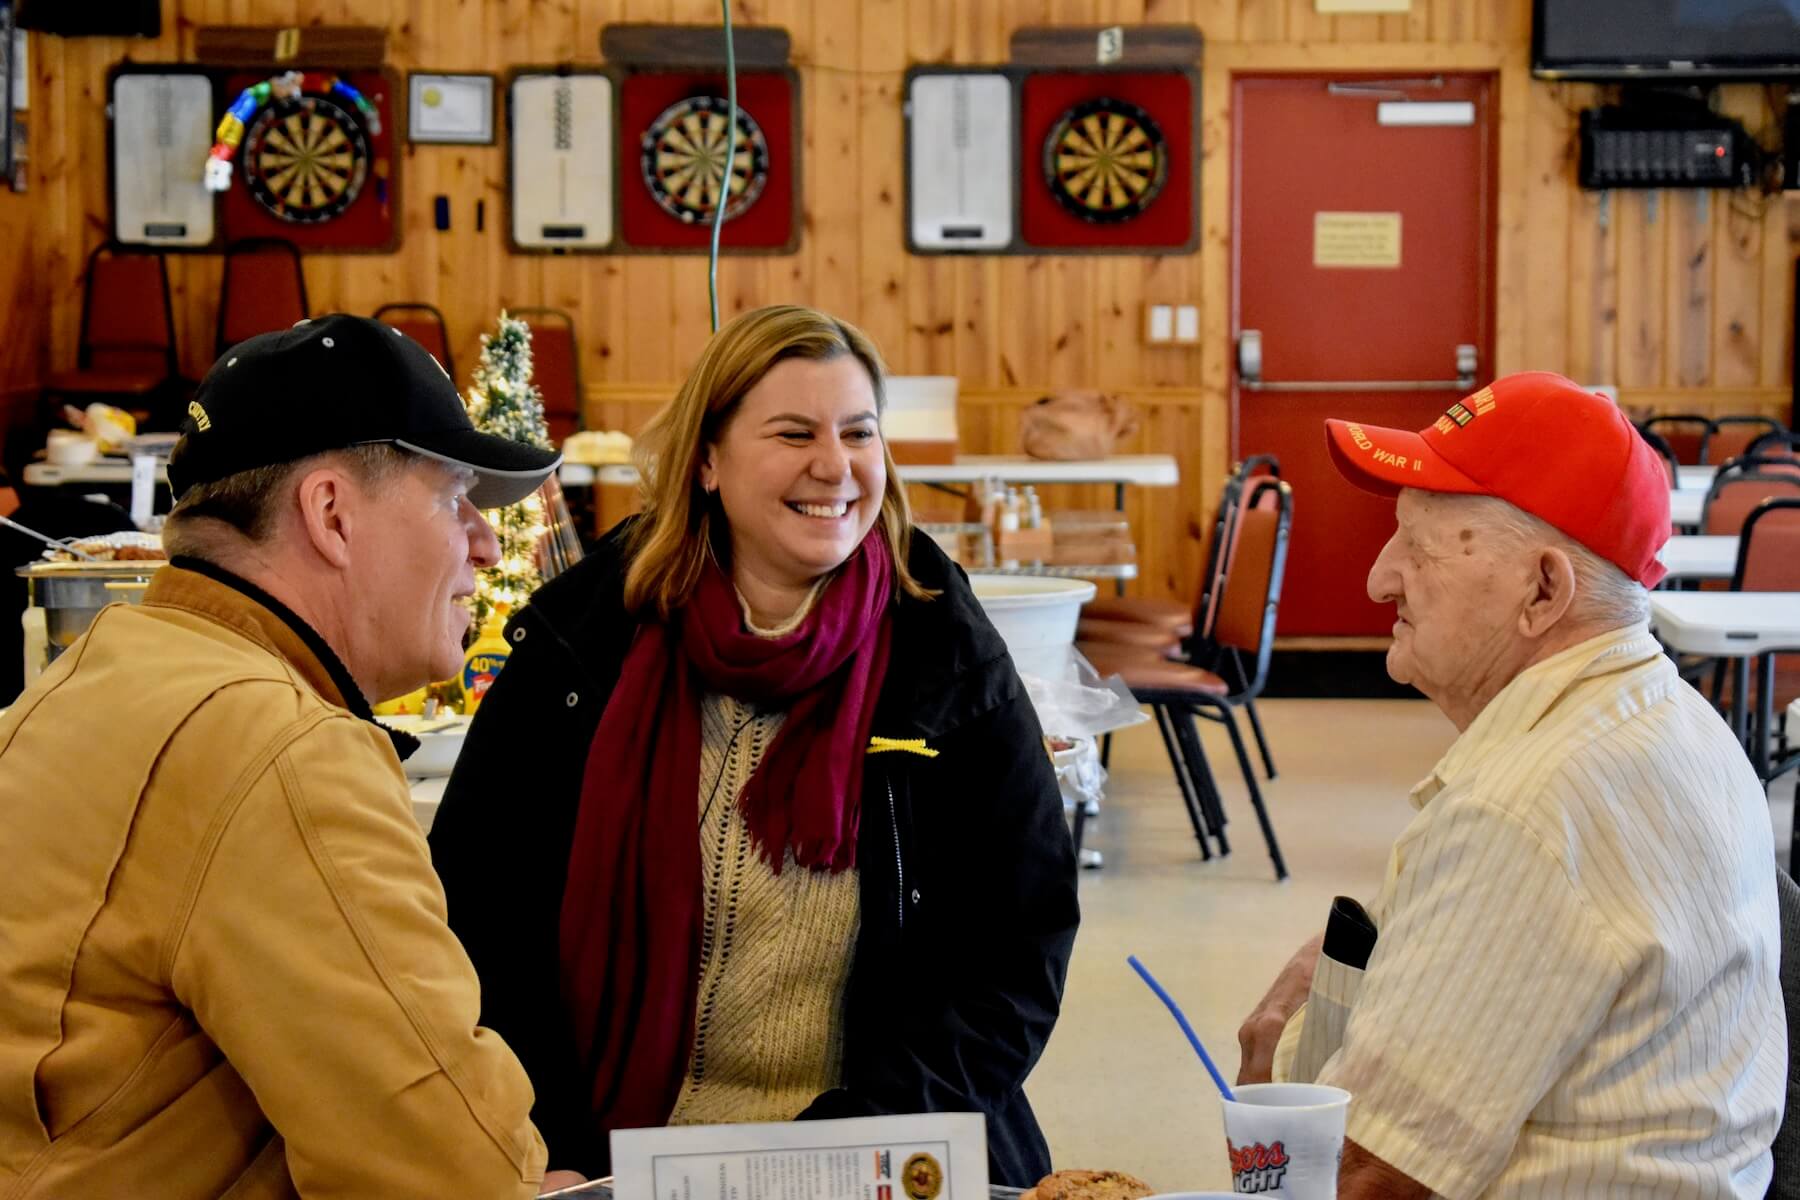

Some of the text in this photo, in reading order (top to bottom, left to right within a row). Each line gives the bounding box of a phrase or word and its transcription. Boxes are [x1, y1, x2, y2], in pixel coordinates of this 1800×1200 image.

[1104, 30, 1117, 55] 3
[1373, 448, 1407, 469] WAR
[1413, 459, 1422, 471] II
[1227, 1136, 1290, 1174] oors
[1233, 1167, 1287, 1193] IGHT
